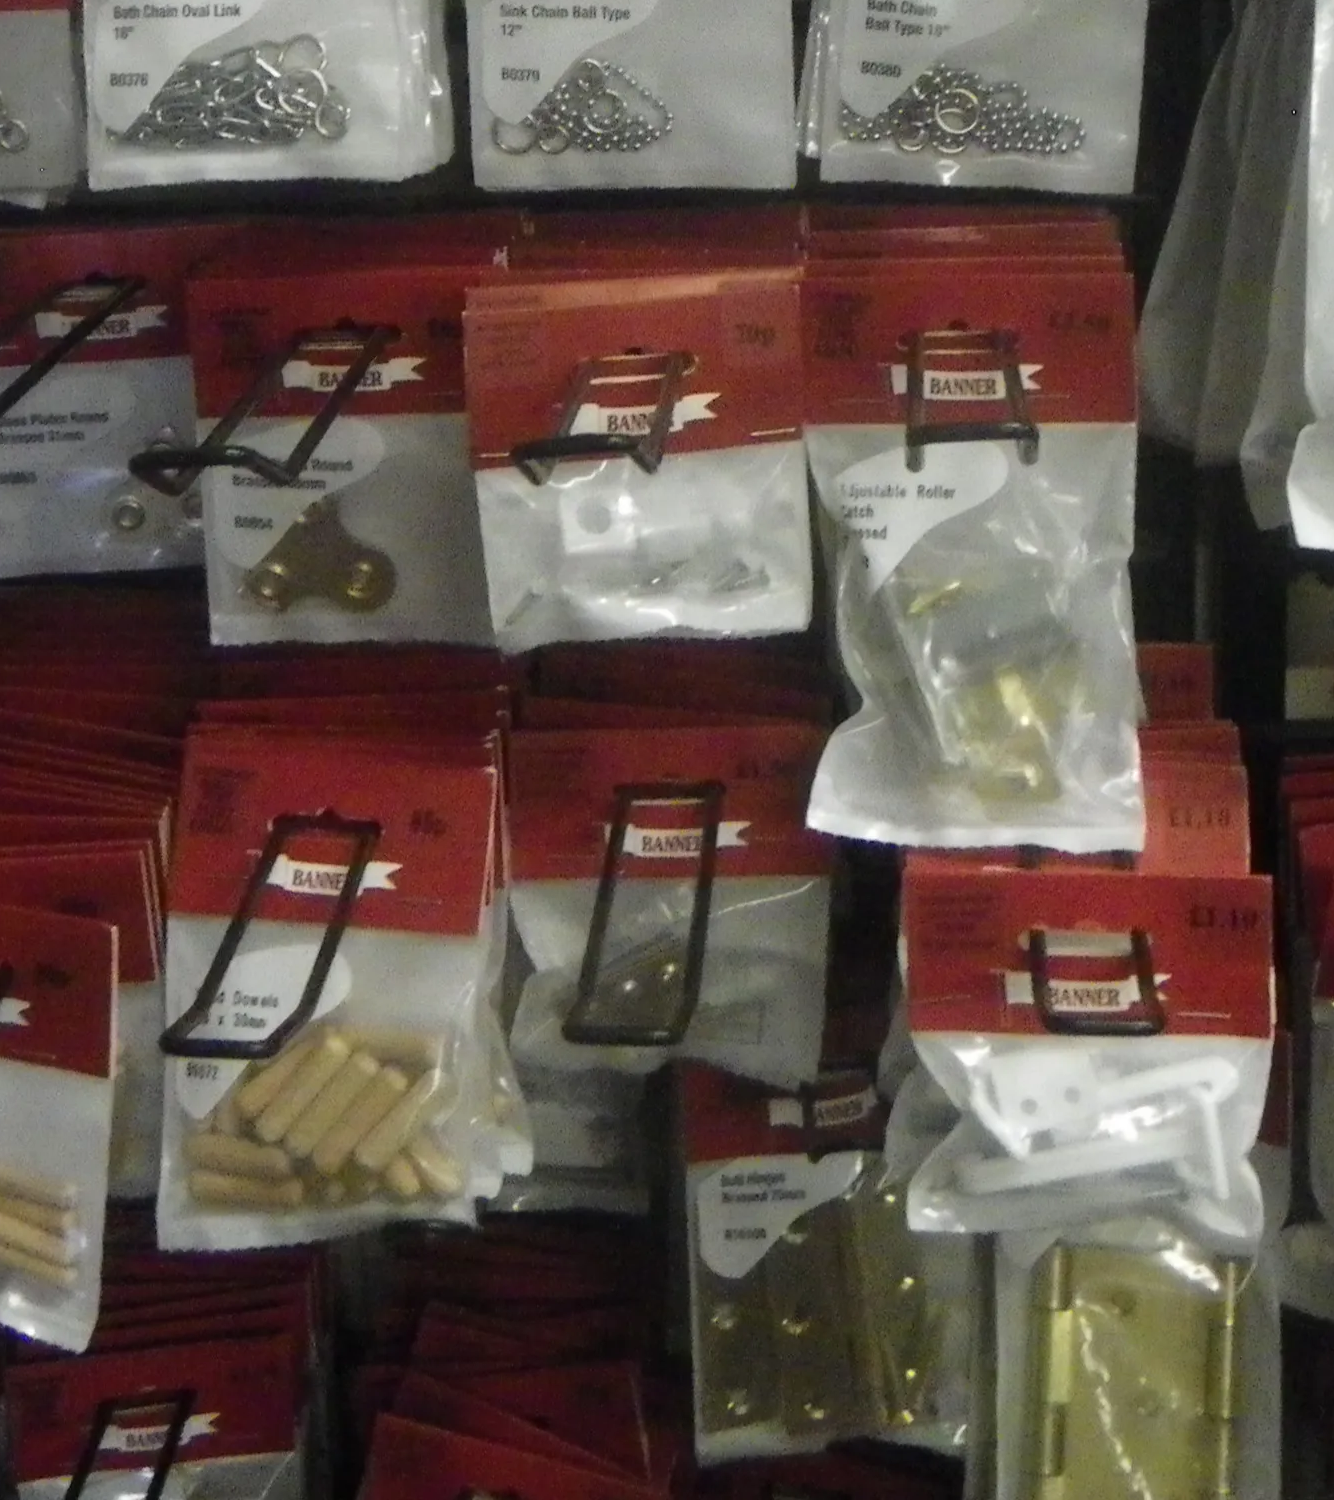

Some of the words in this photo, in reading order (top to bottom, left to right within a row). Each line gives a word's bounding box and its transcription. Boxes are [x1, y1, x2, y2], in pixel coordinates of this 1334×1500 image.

[113, 5, 141, 21] Bath
[143, 4, 179, 20] Chain
[181, 3, 210, 19] Oval
[213, 2, 241, 17] Link
[499, 3, 529, 19] Sink
[531, 4, 569, 20] Chain
[572, 4, 598, 20] Ball
[600, 5, 631, 23] Type
[899, 0, 938, 18] Chain
[865, 17, 892, 35] Ball
[894, 20, 925, 38] Type
[929, 378, 997, 396] BANNER
[916, 484, 956, 501] Roller
